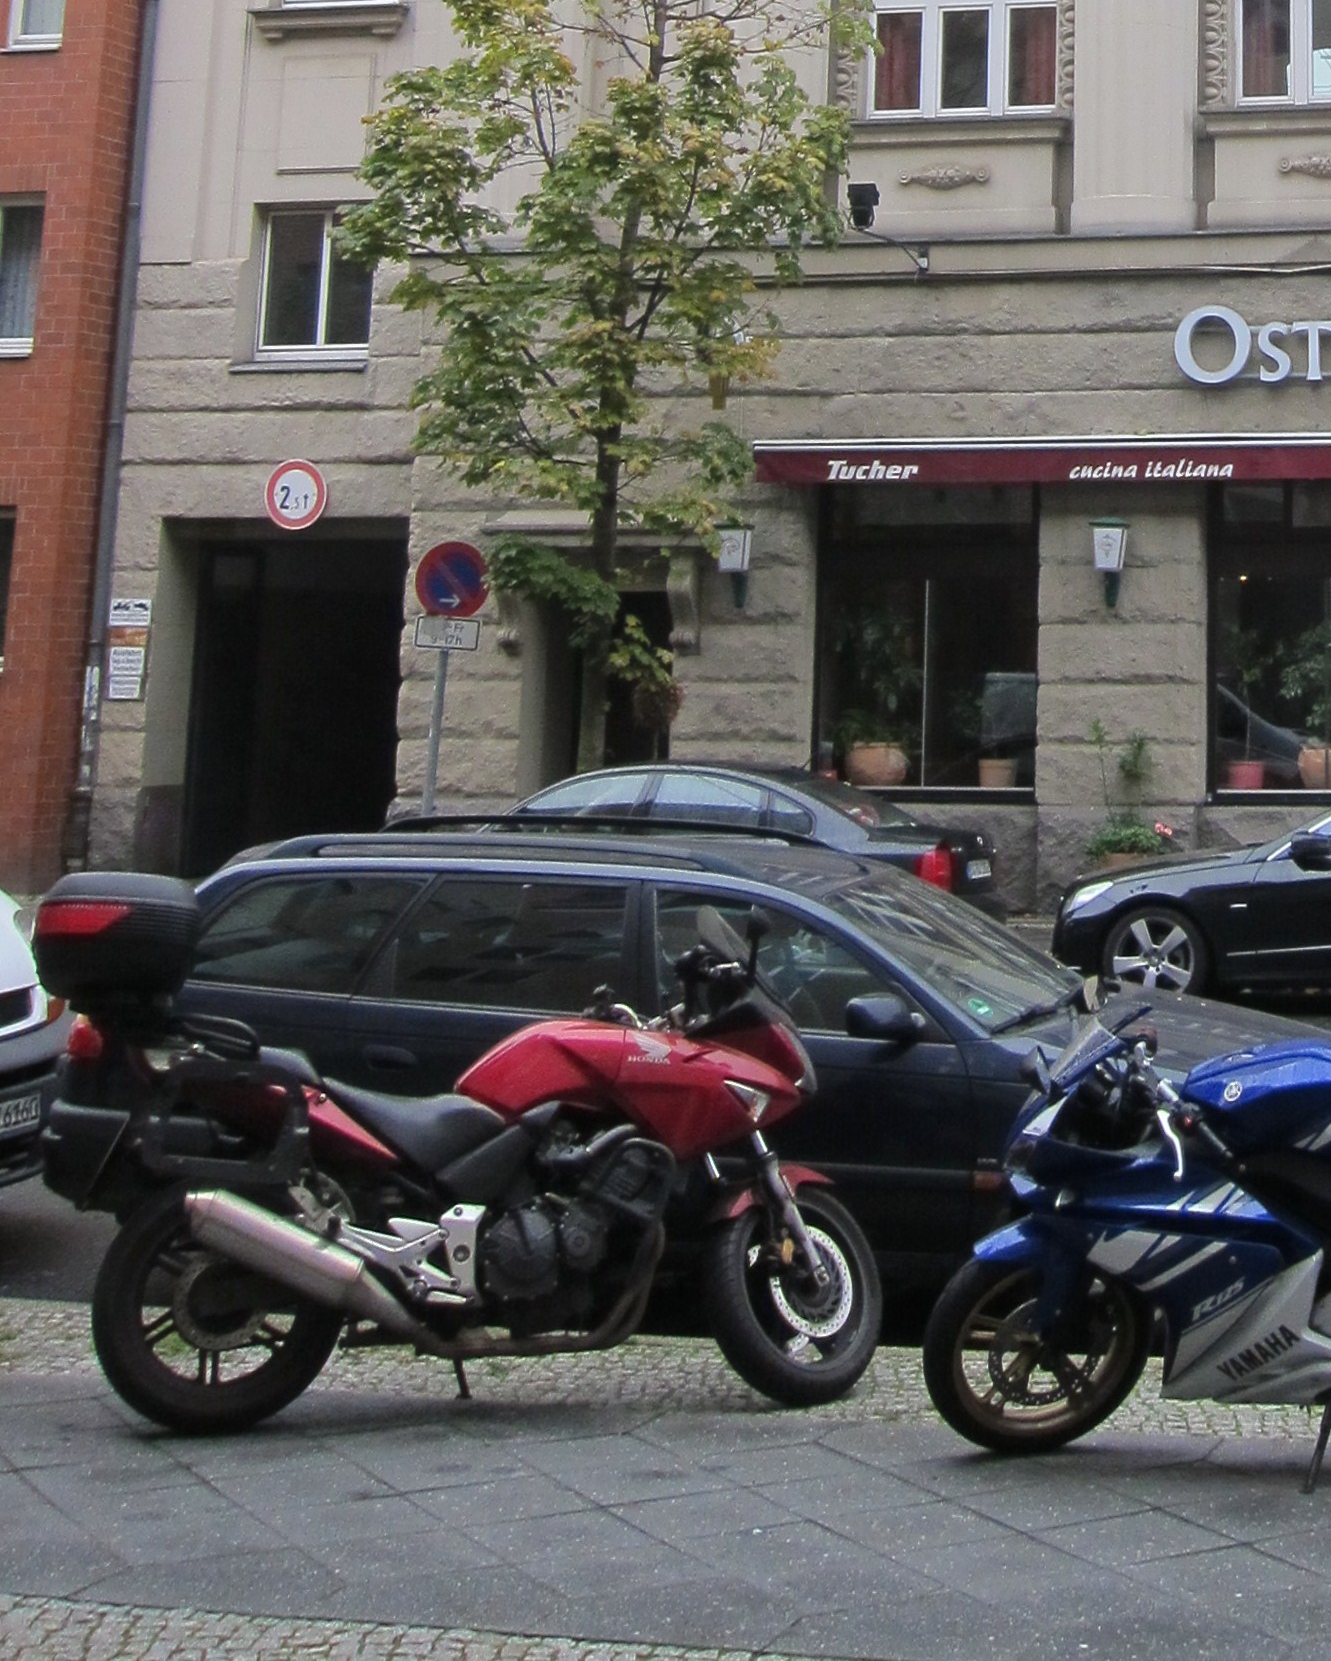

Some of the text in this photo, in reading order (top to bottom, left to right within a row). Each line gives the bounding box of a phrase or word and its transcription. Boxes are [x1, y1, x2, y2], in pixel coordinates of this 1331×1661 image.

[827, 459, 919, 480] Tucher
[1068, 458, 1234, 480] cucina italiana
[1216, 1324, 1300, 1380] YAMAHA
